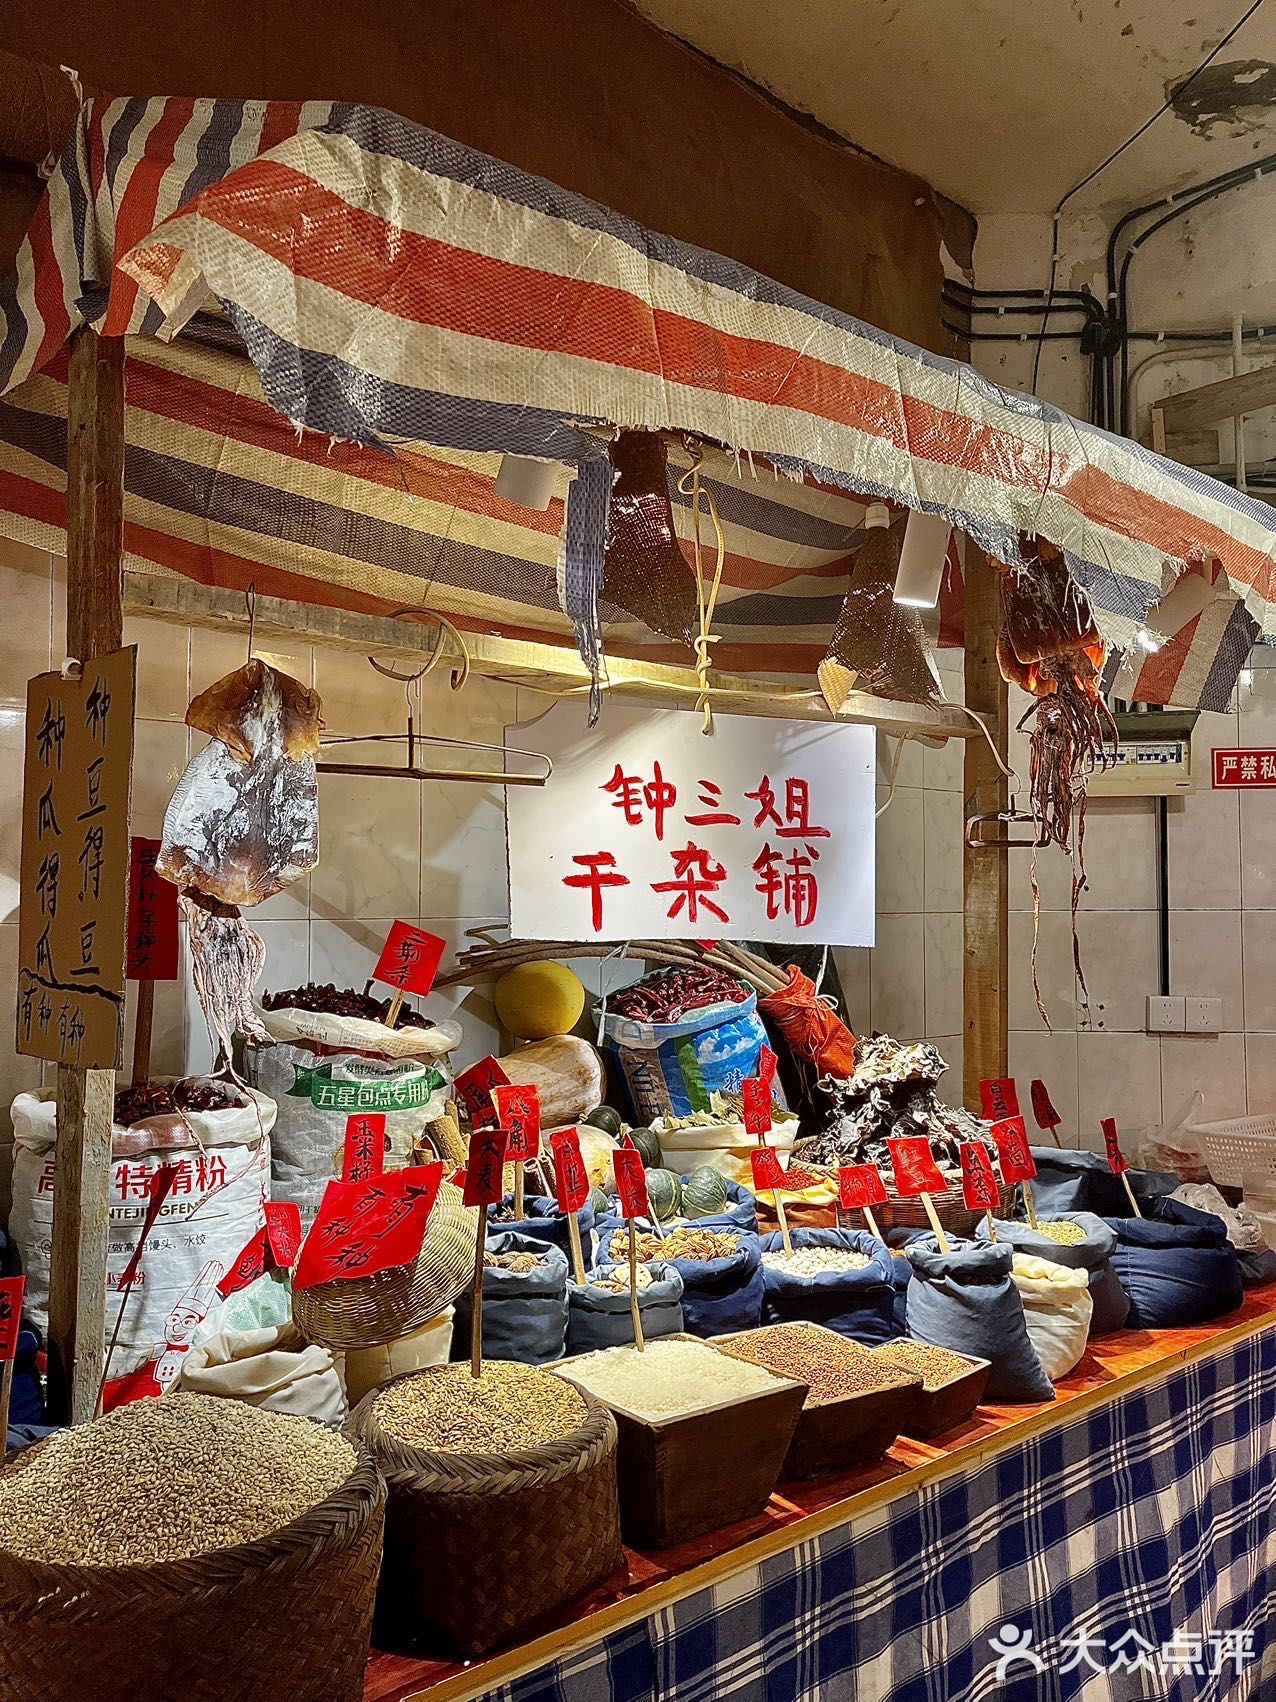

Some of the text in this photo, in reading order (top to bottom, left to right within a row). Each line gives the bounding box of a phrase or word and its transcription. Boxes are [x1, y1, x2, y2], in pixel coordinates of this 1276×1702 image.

[598, 760, 832, 841] 钟三姐
[1221, 755, 1276, 780] 严禁私
[35, 698, 66, 988] 种瓜得瓜
[69, 676, 113, 977] 种豆得豆
[561, 841, 821, 933] 干杂铺
